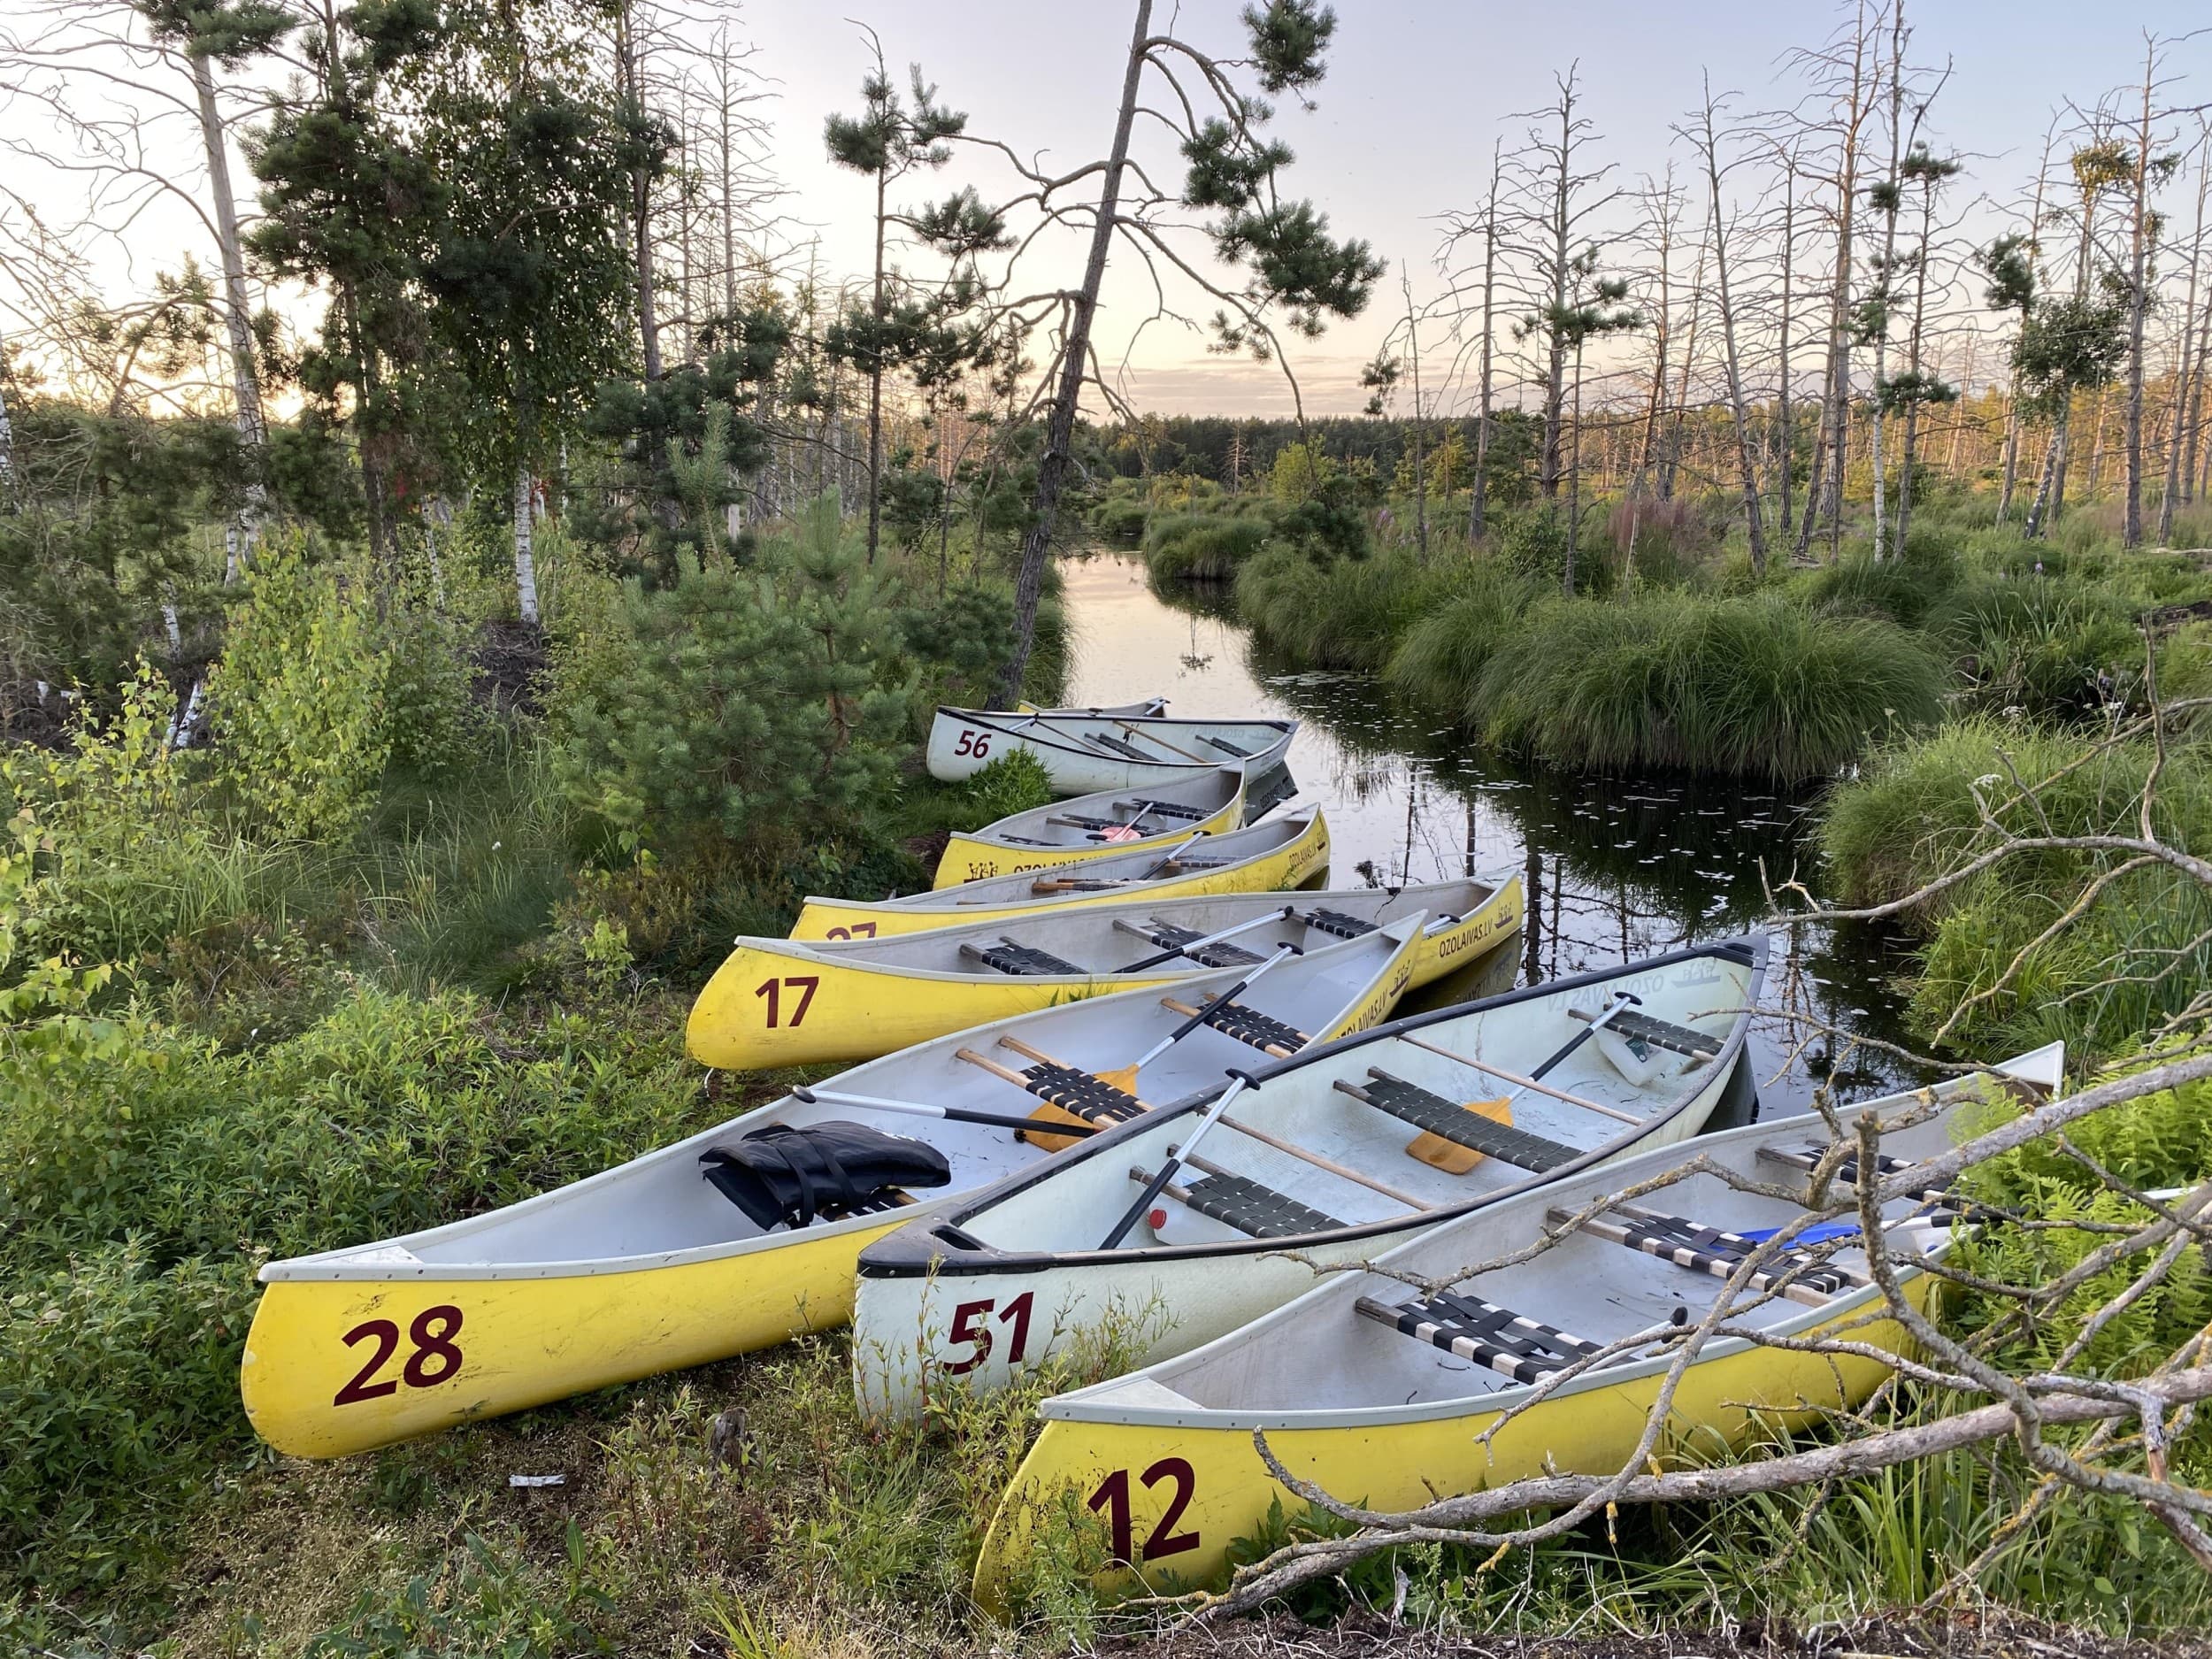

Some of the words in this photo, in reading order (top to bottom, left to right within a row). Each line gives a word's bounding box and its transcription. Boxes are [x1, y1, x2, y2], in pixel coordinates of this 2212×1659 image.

[955, 730, 992, 758] 56
[1439, 918, 1493, 957] OZOLAIVAS.LV
[755, 976, 819, 1028] 17
[333, 1304, 464, 1407] 28
[942, 1291, 1034, 1376] 51
[1087, 1456, 1200, 1570] 12
